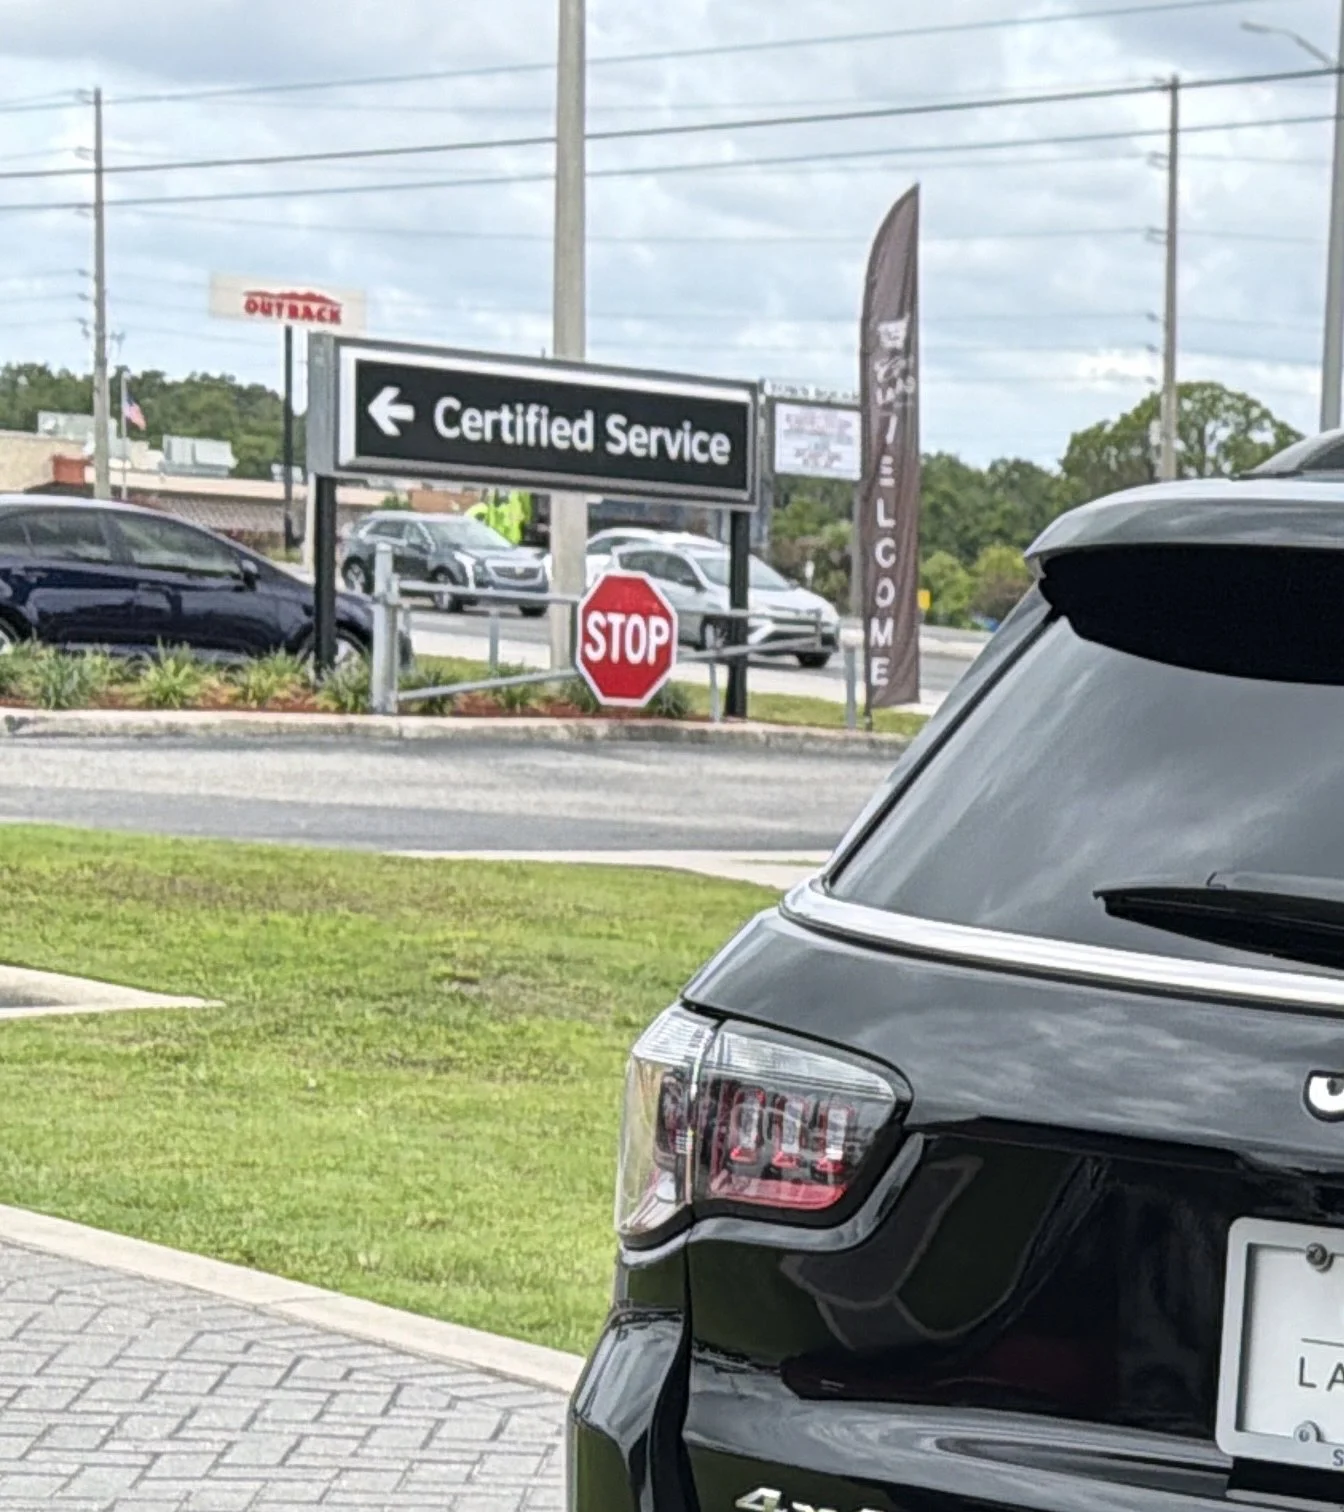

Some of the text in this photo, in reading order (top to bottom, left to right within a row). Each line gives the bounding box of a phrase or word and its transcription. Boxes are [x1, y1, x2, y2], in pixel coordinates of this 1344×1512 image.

[244, 299, 342, 325] OUTBACK
[433, 396, 594, 453] Certified
[605, 413, 731, 465] Service
[584, 610, 670, 667] STOP
